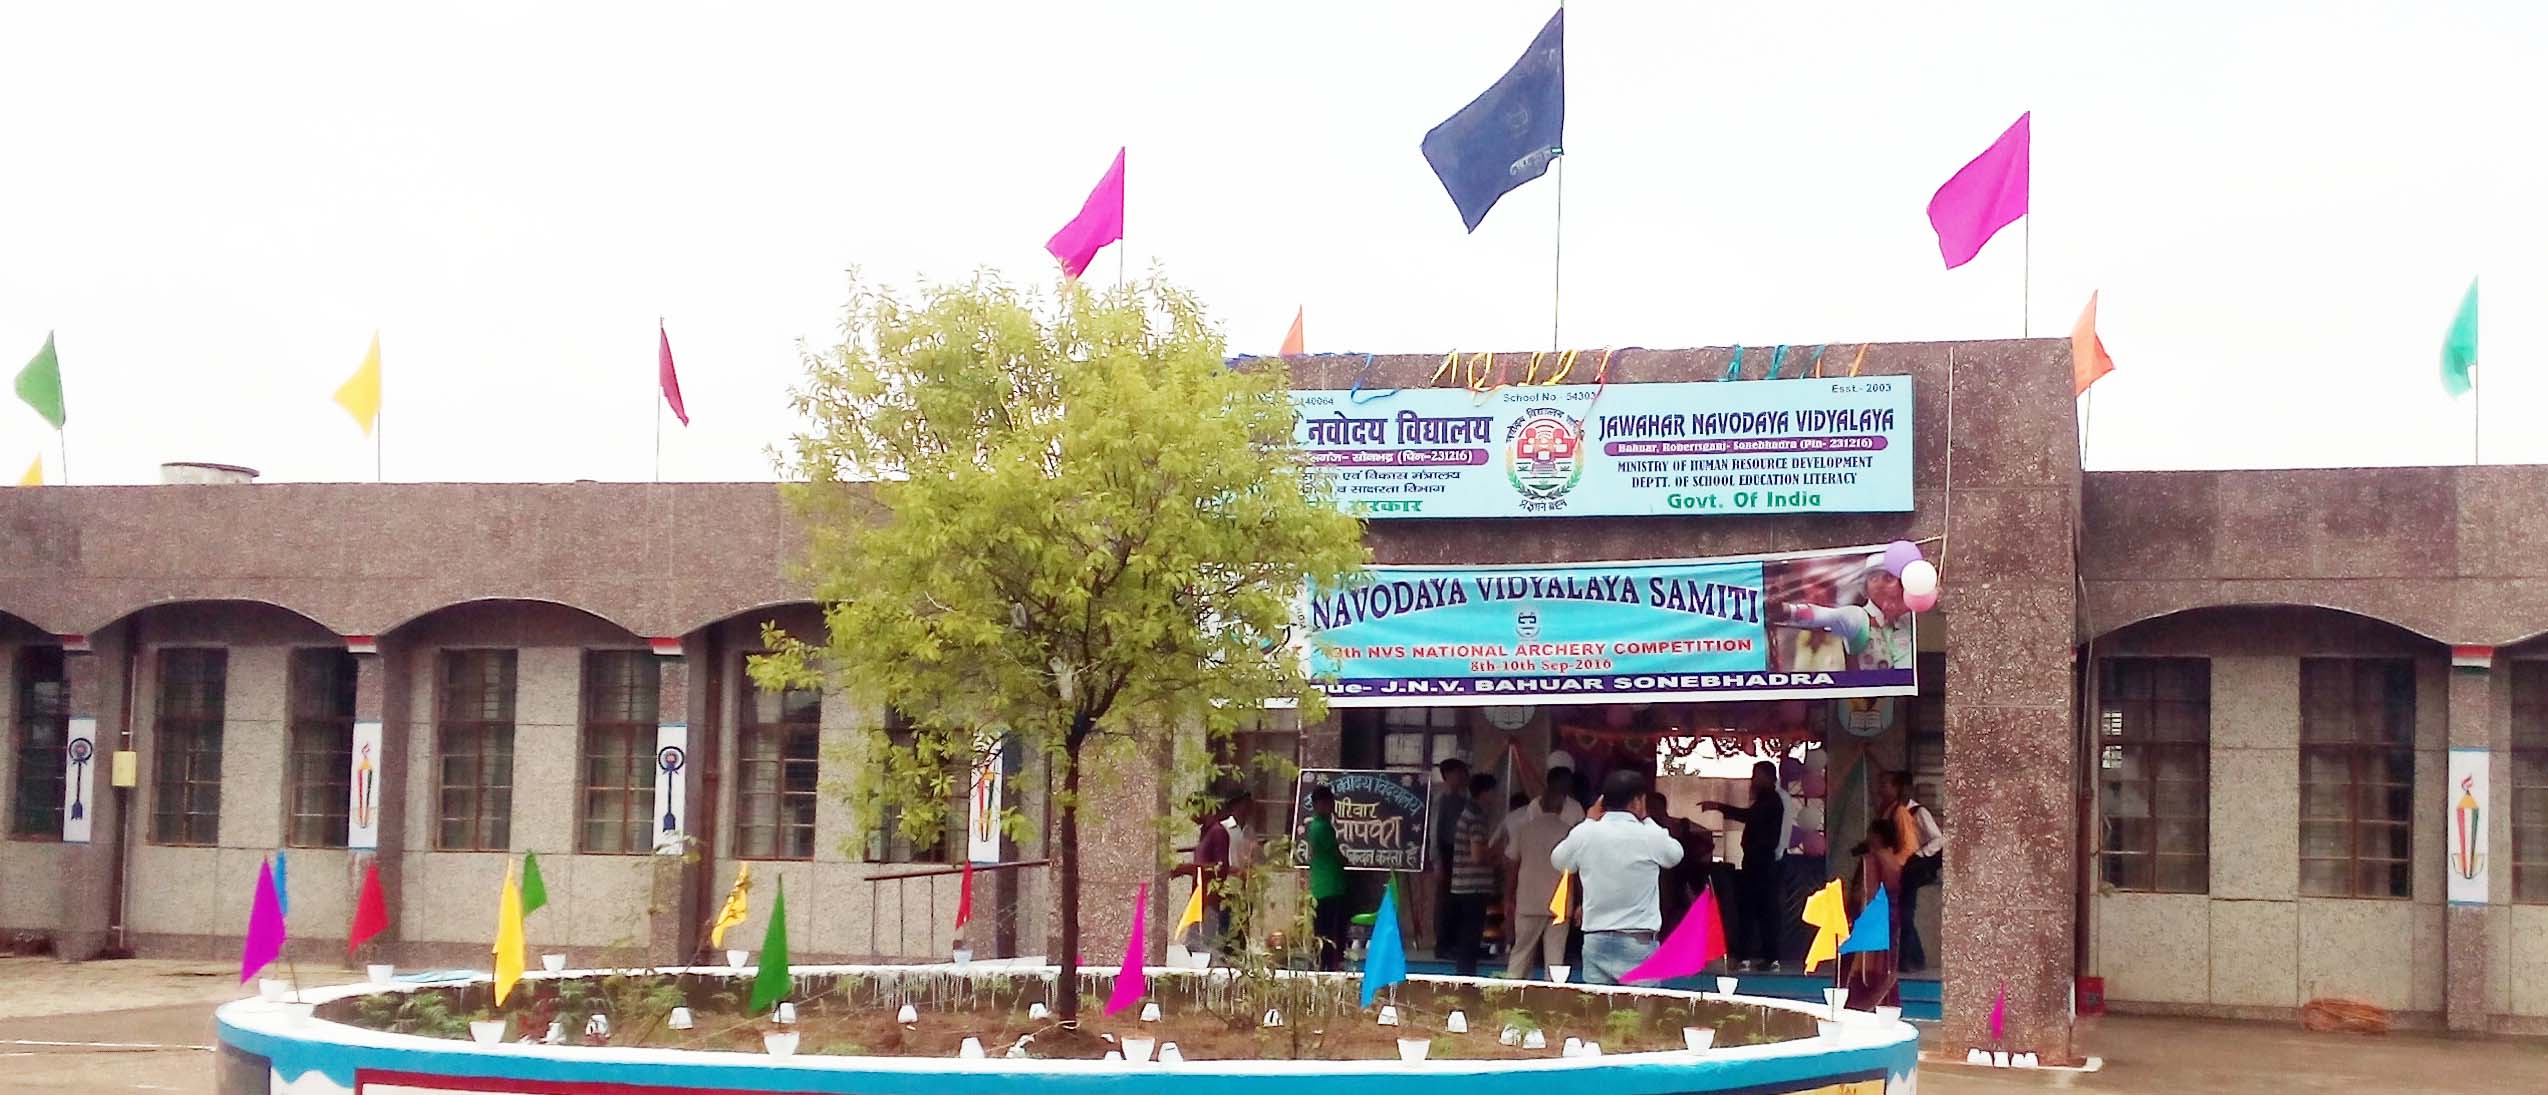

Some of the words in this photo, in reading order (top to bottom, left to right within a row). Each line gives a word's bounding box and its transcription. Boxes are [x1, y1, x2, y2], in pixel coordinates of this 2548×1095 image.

[1866, 383, 1891, 392] 2003
[1504, 393, 1539, 402] School
[1306, 411, 1388, 445] नवोदय
[1396, 410, 1493, 444] विद्यालय
[1598, 413, 1686, 440] JAWAHAR
[1692, 410, 1789, 435] NAVODAYA
[1795, 408, 1894, 432] VIDYALAYA
[1733, 439, 1797, 450] Sonebhadra
[1829, 438, 1873, 449] 231216)
[1617, 460, 1668, 472] MINISTRY
[1672, 460, 1687, 470] OF
[1690, 459, 1728, 471] HUMAN
[1732, 458, 1788, 470] RESOURCE
[1792, 456, 1873, 469] DEVELOPMENT
[1364, 469, 1408, 480] विकास
[1412, 469, 1460, 480] मंत्रालय
[1632, 476, 1670, 488] DEPTT.
[1675, 476, 1689, 487] OF
[1692, 475, 1735, 487] SCHOOL
[1739, 473, 1799, 486] EDUCATION
[1803, 473, 1857, 485] LITERACY
[1351, 485, 1399, 494] साक्षरता
[1404, 483, 1446, 493] विभाग
[1667, 494, 1724, 509] Govt.
[1733, 492, 1758, 508] Of
[1768, 491, 1821, 507] India
[1312, 576, 1467, 632] NAVODAYA
[1476, 575, 1640, 604] VIDYALAYA
[1650, 576, 1759, 624] SAMITI
[1368, 646, 1405, 658] NVS
[1412, 645, 1508, 658] NATIONAL
[1515, 643, 1606, 656] ARCHERY
[1614, 639, 1752, 655] COMPETITION
[1471, 661, 1535, 672] 8th-10th
[1541, 659, 1612, 673] Sep-2016
[1309, 684, 1372, 693] nue-
[1380, 681, 1465, 693] J.N.V.
[1475, 678, 1604, 692] BAHUAR
[1613, 672, 1835, 690] SONEBHADRA
